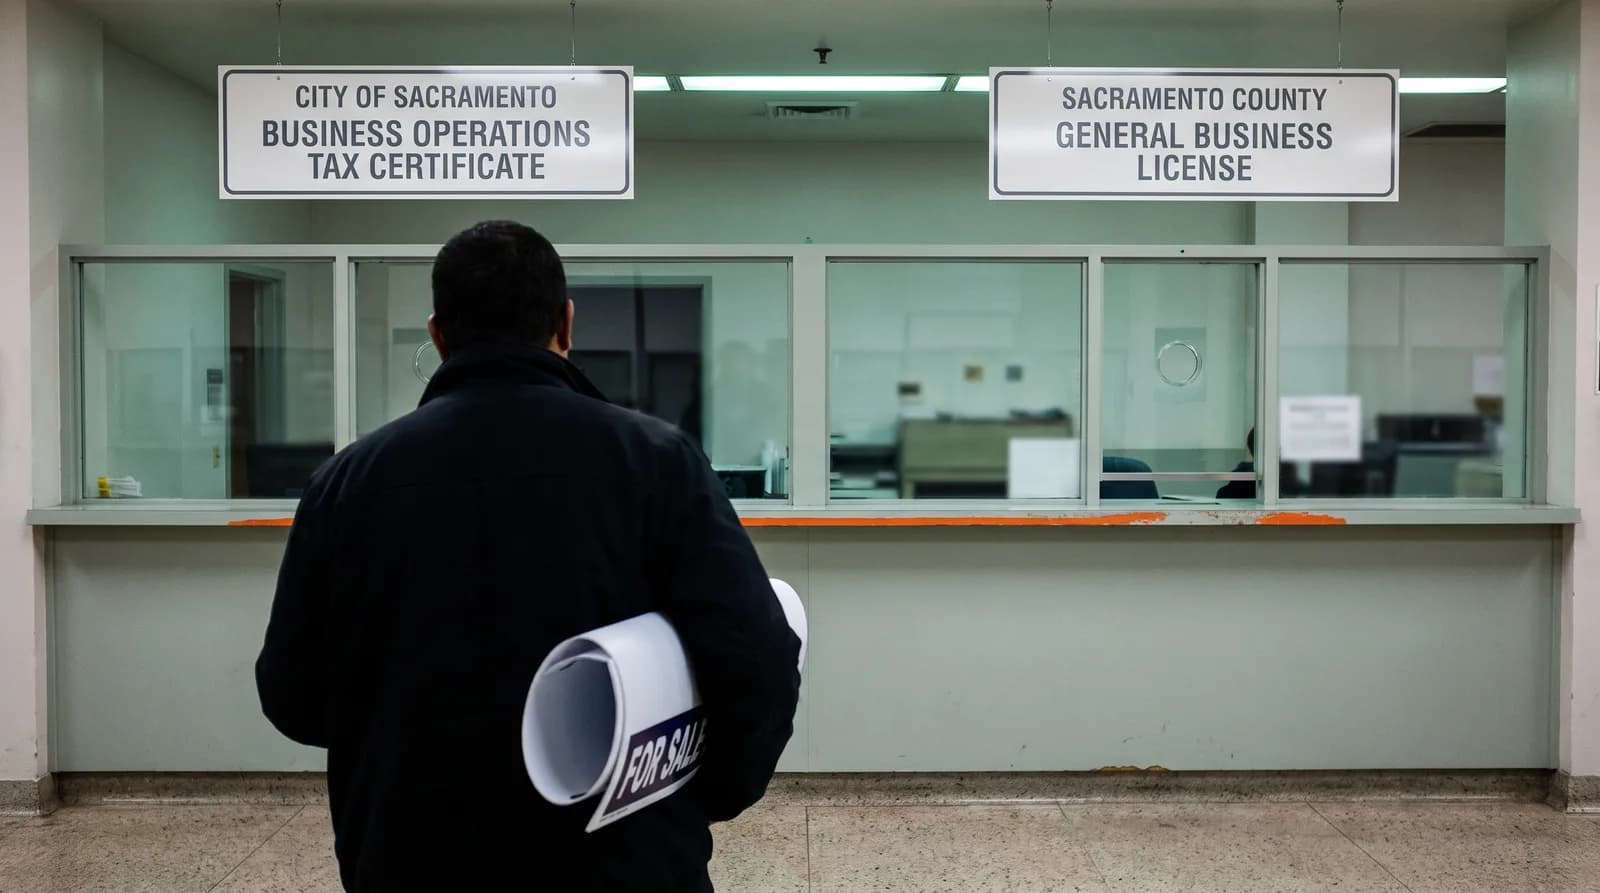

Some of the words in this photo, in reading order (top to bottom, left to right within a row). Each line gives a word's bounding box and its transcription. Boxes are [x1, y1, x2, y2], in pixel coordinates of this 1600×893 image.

[296, 85, 348, 108] CITY
[356, 85, 386, 108] OF
[394, 85, 557, 109] SACRAMENTO
[1062, 87, 1224, 110] SACRAMENTO
[1232, 88, 1328, 111] COUNTY
[262, 120, 403, 147] BUSINESS
[413, 120, 590, 147] OPERATIONS
[1056, 122, 1185, 149] GENERAL
[1195, 123, 1333, 149] BUSINESS
[308, 153, 359, 180] TAX
[369, 153, 545, 180] CERTIFICATE
[1138, 155, 1252, 181] LICENSE
[616, 735, 667, 800] FOR
